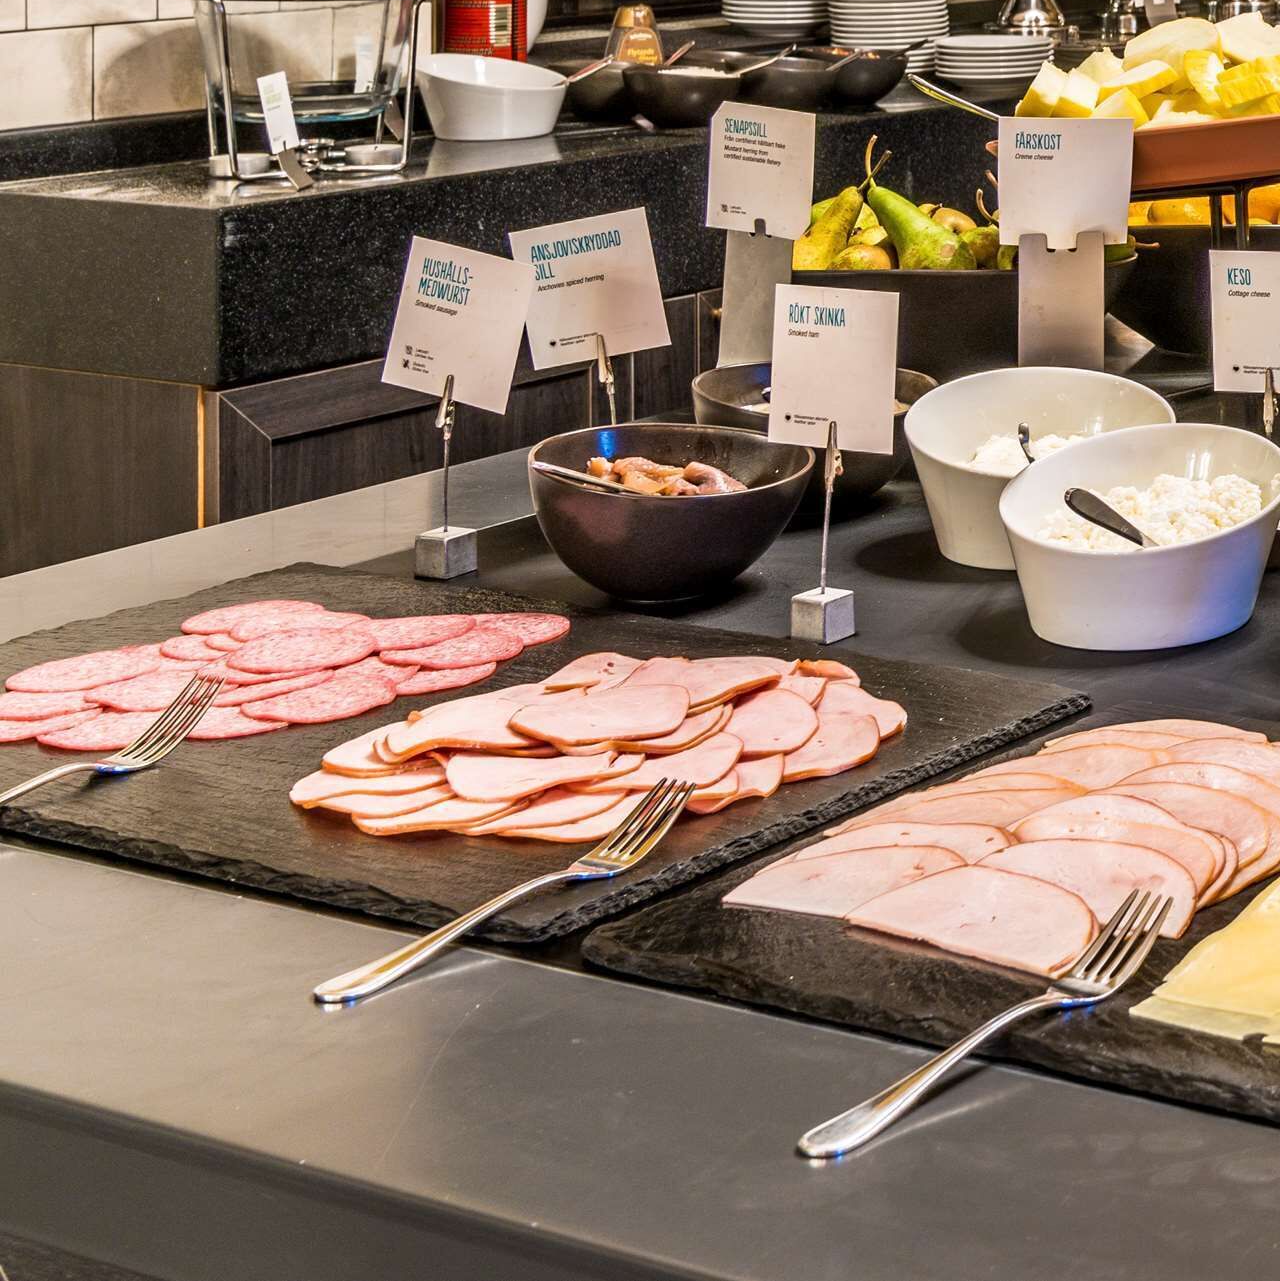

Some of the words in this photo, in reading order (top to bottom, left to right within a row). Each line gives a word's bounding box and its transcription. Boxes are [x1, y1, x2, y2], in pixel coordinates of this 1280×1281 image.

[724, 118, 768, 138] SENAPSSILL
[530, 230, 621, 262] ANSJOVISKRYDDAD
[422, 257, 474, 285] HUSHÅLLS-
[534, 261, 555, 281] SILL
[584, 273, 605, 283] herring
[1227, 268, 1252, 286] KESO
[418, 277, 471, 306] MEDWURST
[415, 299, 436, 311] Smoked
[436, 305, 459, 317] sausage
[788, 302, 811, 325] RÖKT
[814, 306, 846, 327] SKINKA
[787, 329, 808, 338] Smoked
